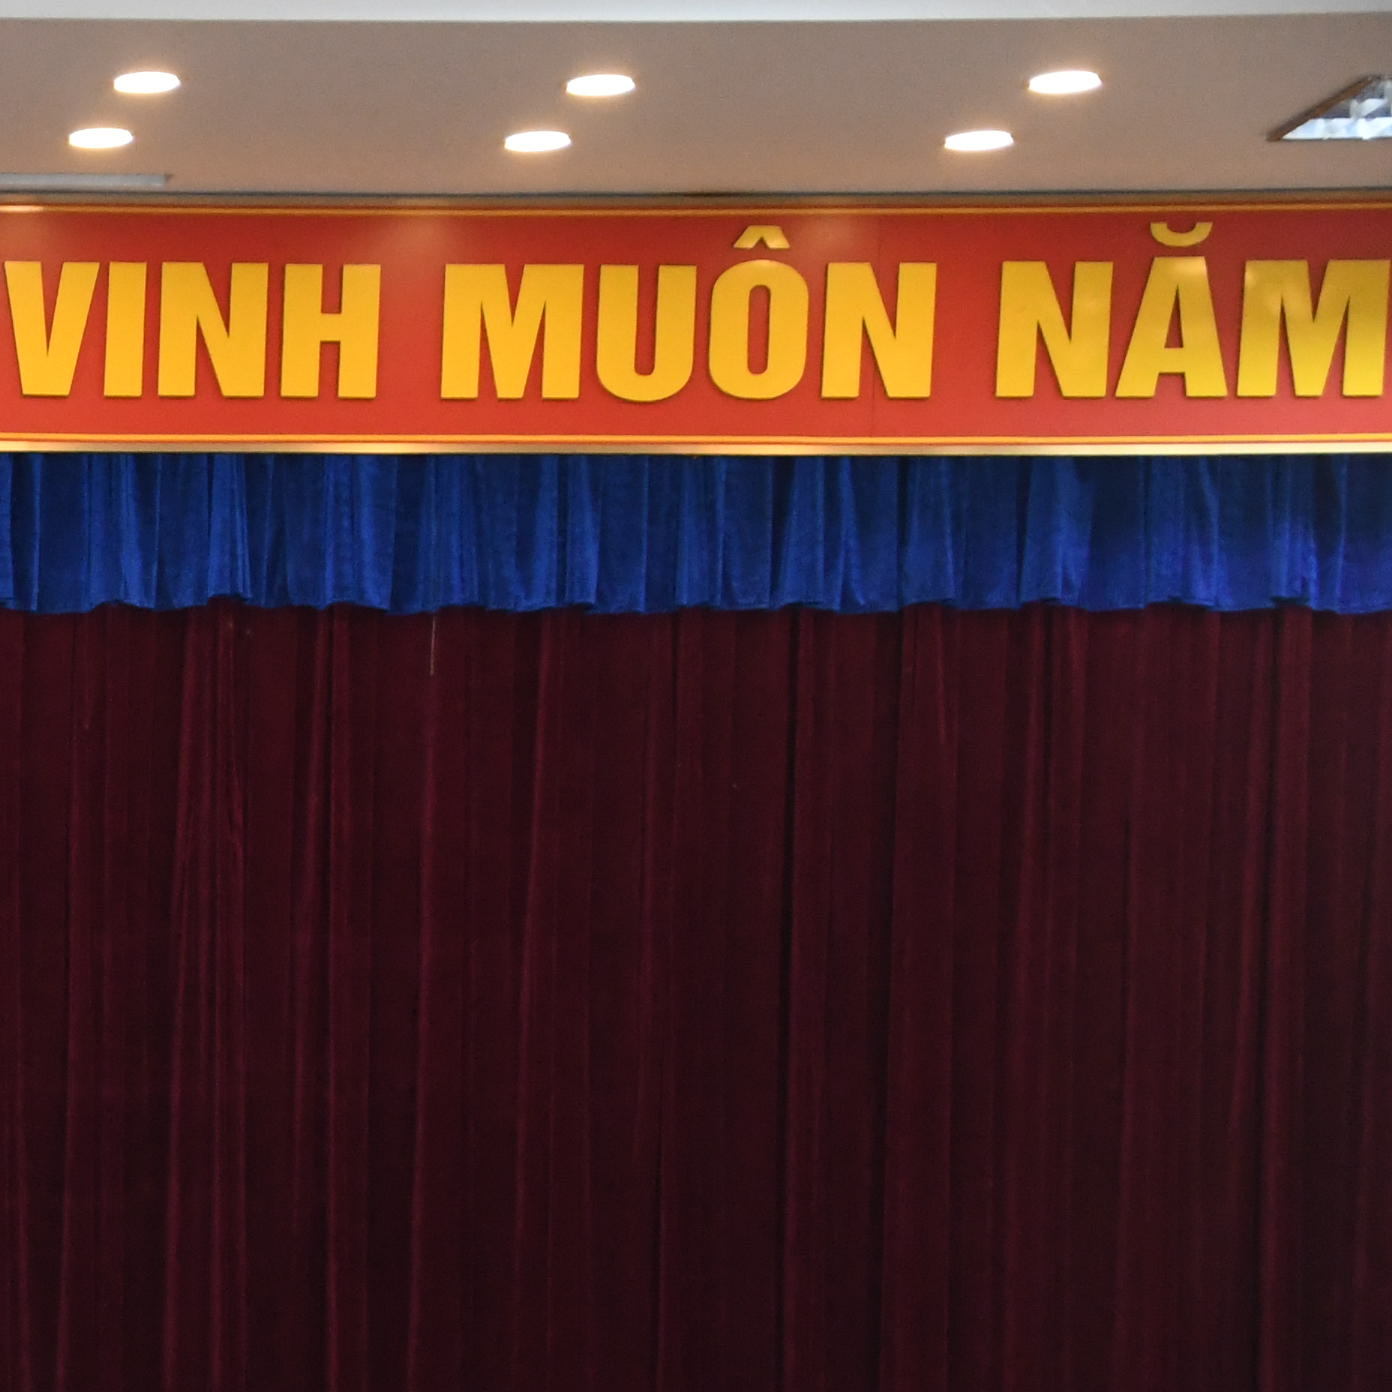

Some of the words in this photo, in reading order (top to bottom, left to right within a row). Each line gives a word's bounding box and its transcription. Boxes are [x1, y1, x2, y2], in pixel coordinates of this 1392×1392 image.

[3, 260, 382, 399] VINH
[440, 225, 937, 402] MUÔN
[995, 222, 1390, 398] NĂM
